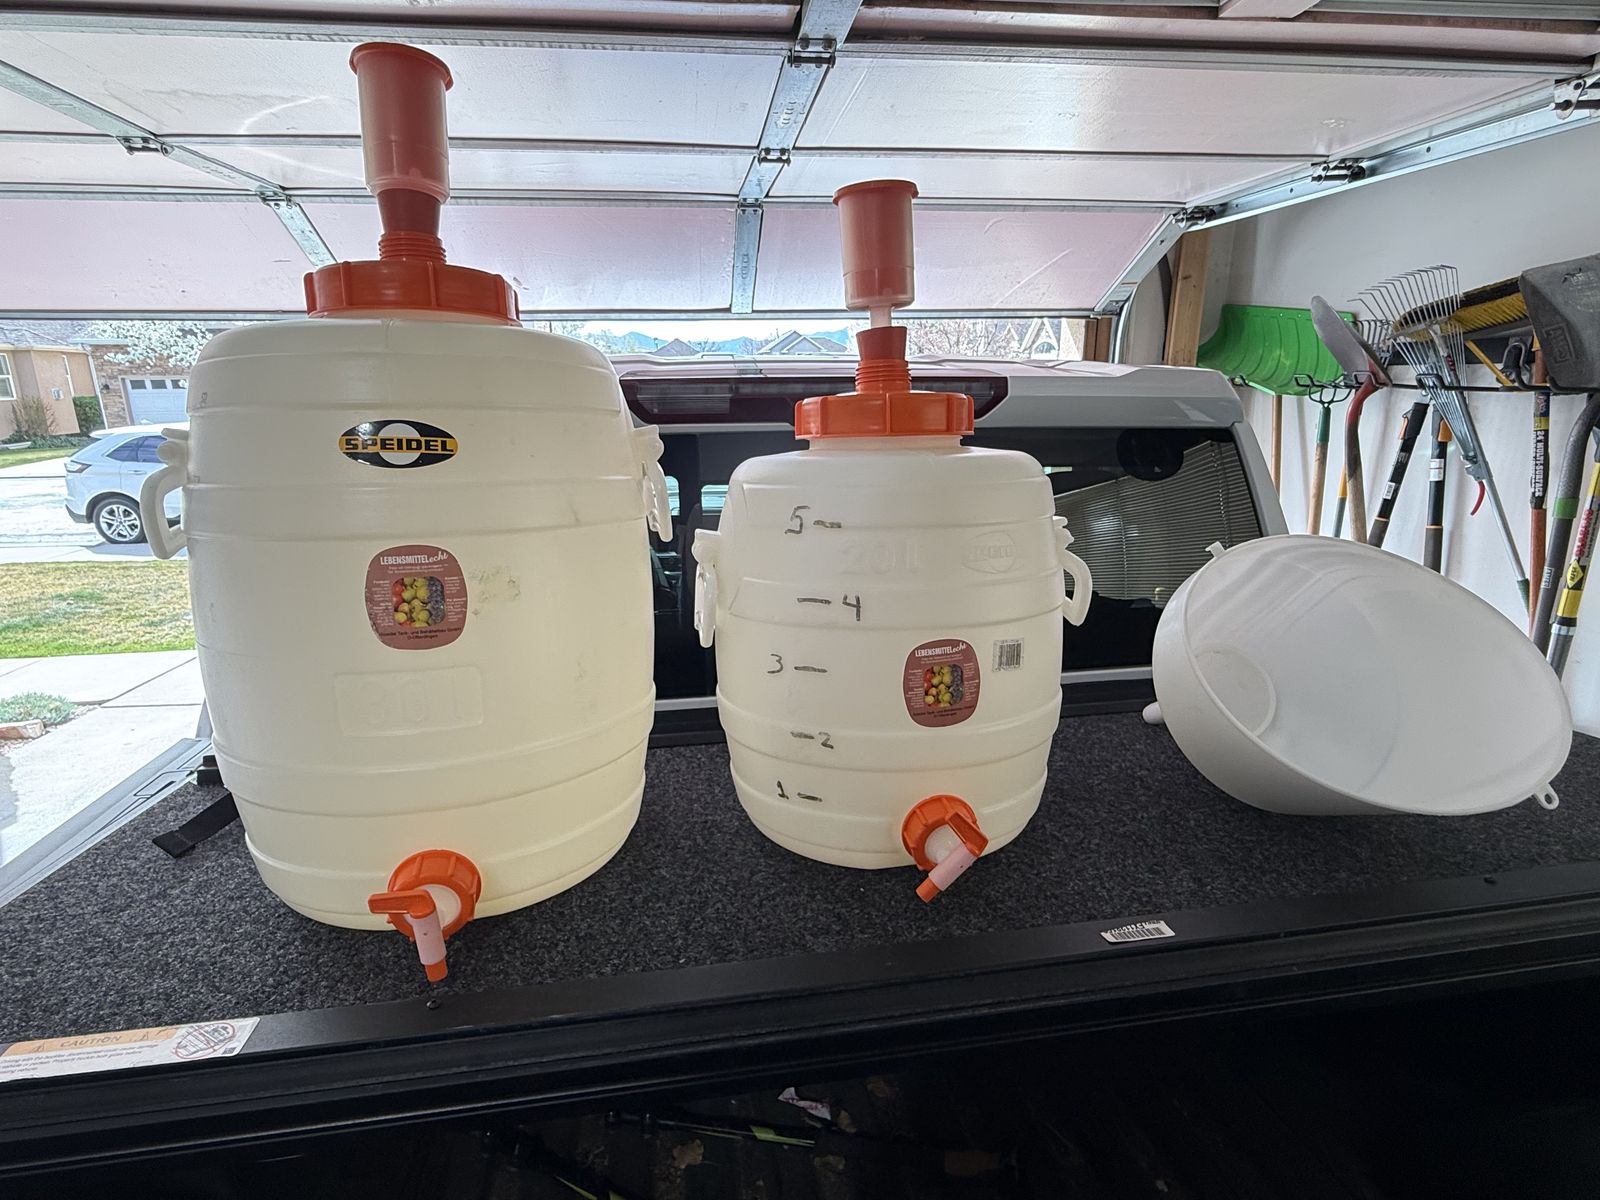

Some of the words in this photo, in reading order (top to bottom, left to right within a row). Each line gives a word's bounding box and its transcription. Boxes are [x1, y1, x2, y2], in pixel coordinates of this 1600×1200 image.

[345, 437, 454, 453] SPEIDEL
[1535, 442, 1545, 498] MULTI-SURFACE
[784, 505, 811, 534] 5
[842, 594, 861, 621] 4
[767, 653, 784, 674] 3
[818, 731, 834, 749] 2
[776, 780, 790, 800] 1
[60, 1036, 122, 1047] CAUTION
